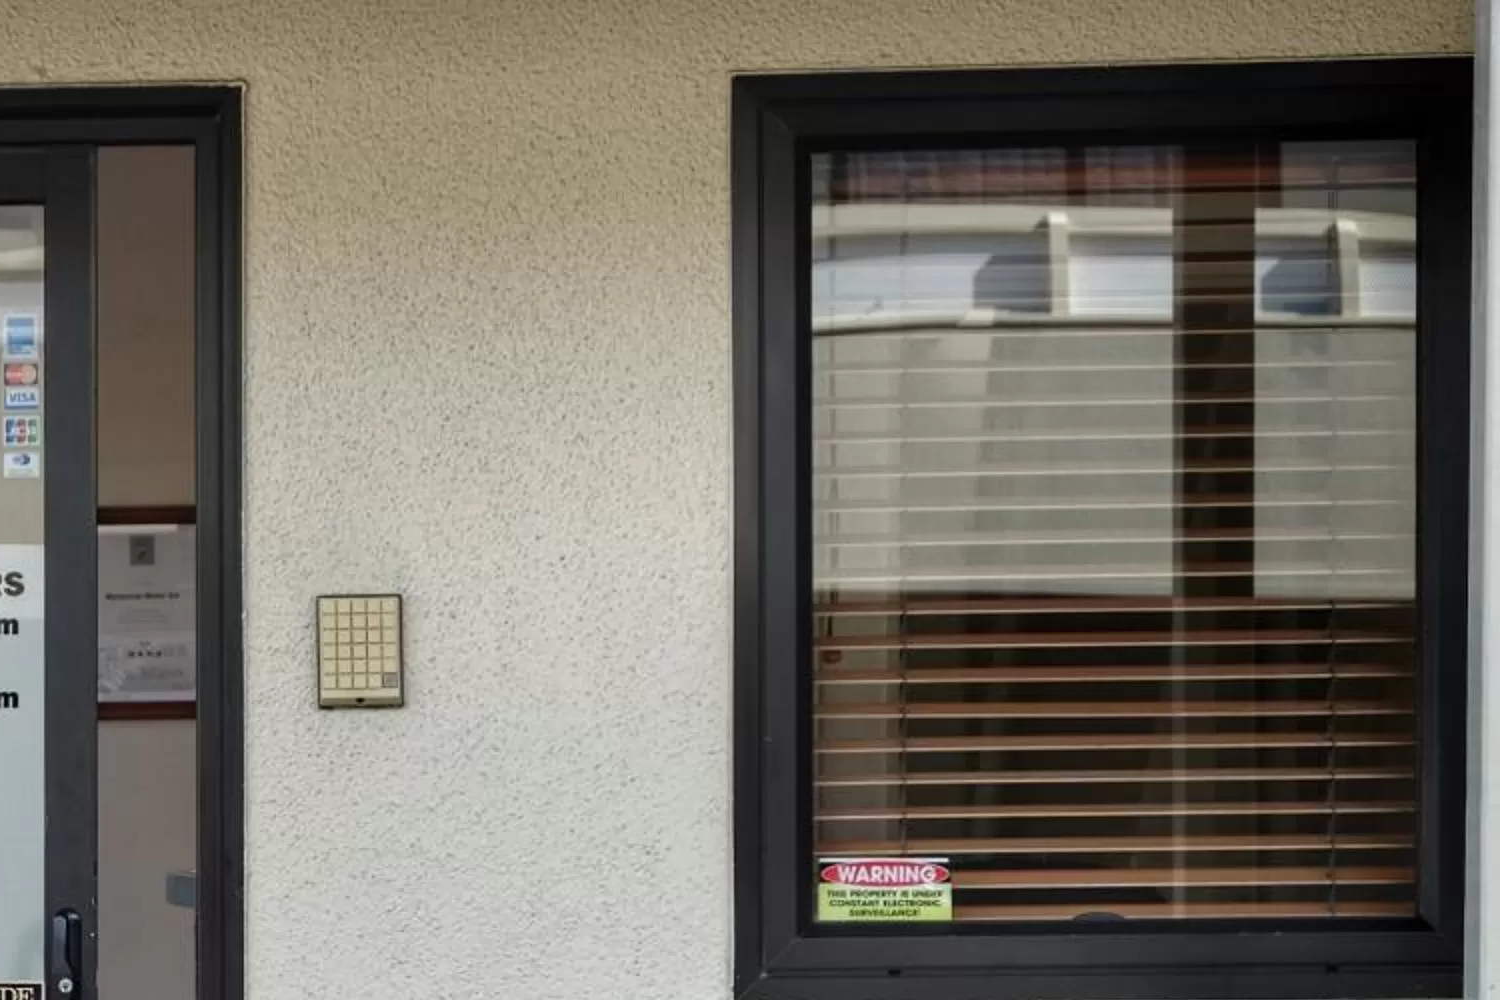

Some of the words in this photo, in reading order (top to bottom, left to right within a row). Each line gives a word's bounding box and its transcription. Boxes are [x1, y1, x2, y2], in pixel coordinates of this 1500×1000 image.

[9, 392, 37, 403] VISA
[837, 864, 937, 883] WARNING
[850, 889, 897, 898] PROPERTY
[829, 899, 879, 907] CONSTANT
